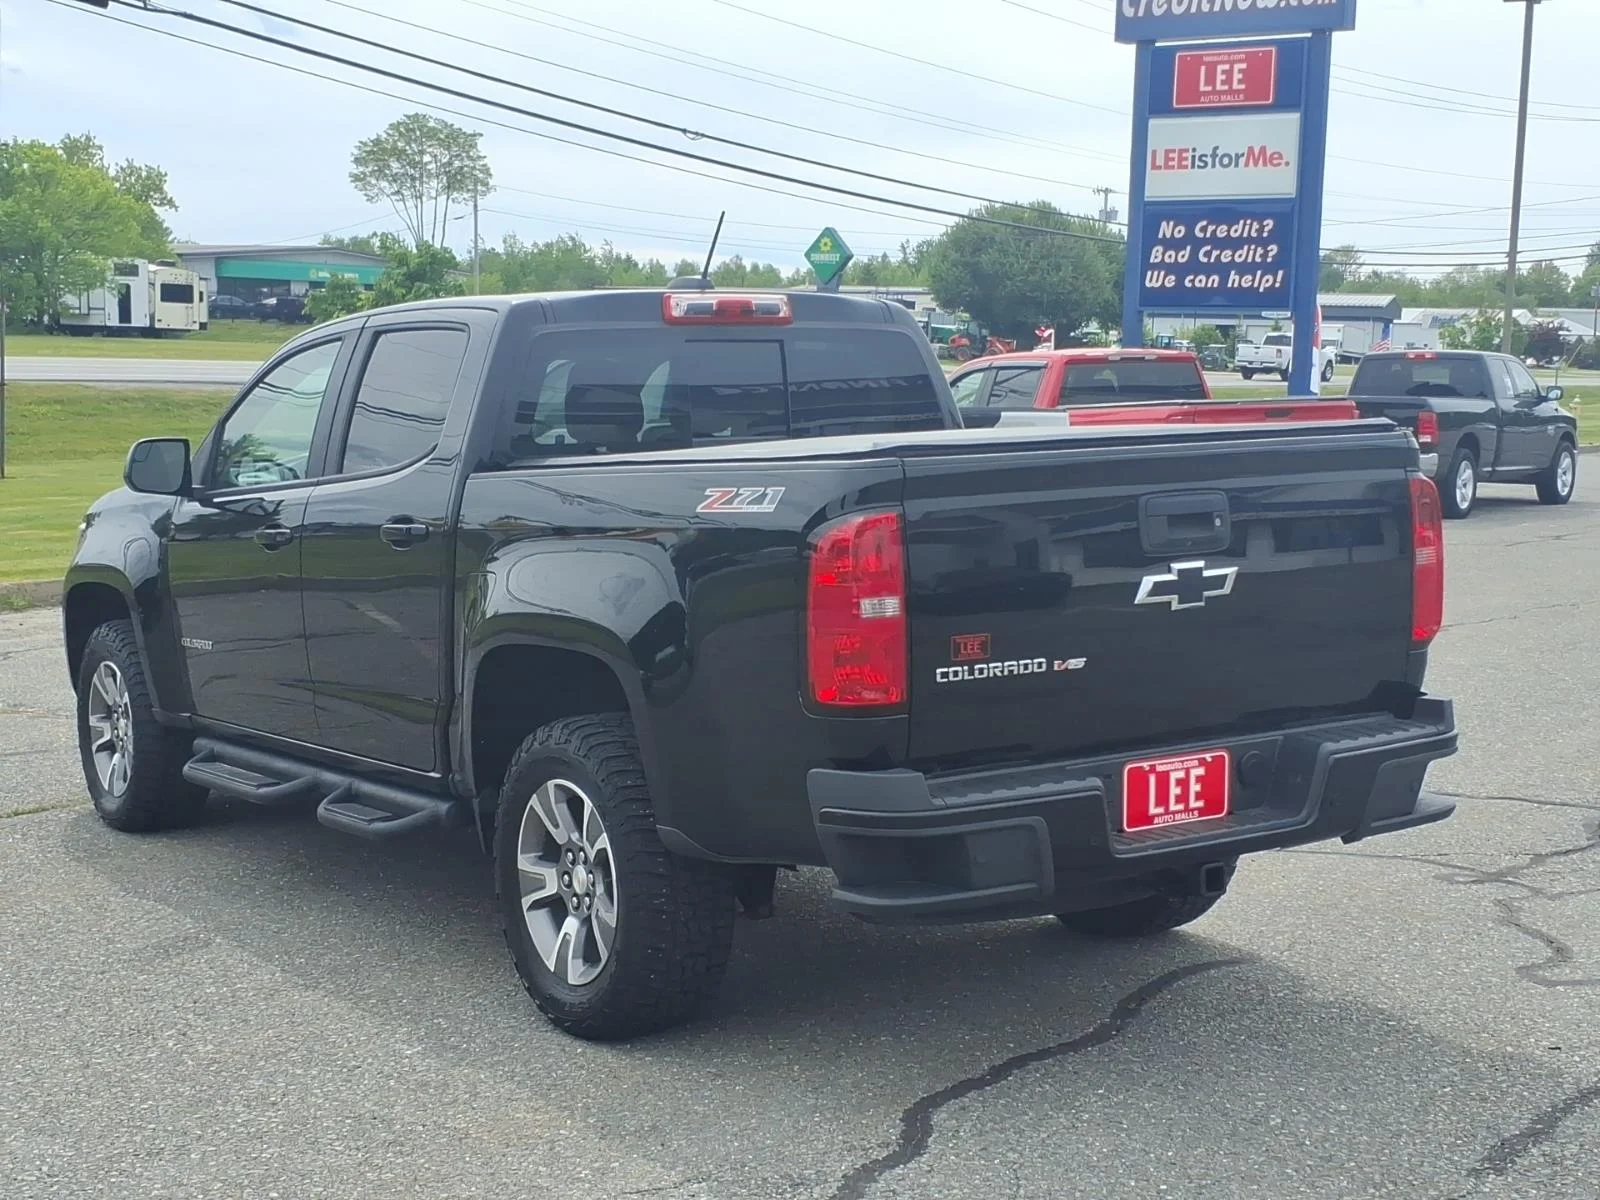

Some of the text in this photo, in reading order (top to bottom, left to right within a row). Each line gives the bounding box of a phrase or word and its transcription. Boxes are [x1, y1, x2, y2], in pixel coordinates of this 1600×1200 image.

[1200, 63, 1247, 91] LEE
[1150, 145, 1290, 171] LEEisforMe.
[1158, 219, 1274, 239] No Credit?
[1150, 244, 1278, 263] Bad Credit?
[1144, 269, 1284, 293] We can help!
[696, 487, 786, 512] Z71
[960, 641, 983, 653] LEE
[936, 658, 1047, 682] COLORADO
[1148, 766, 1206, 816] LEE
[1153, 810, 1199, 824] AUTO MALLS
